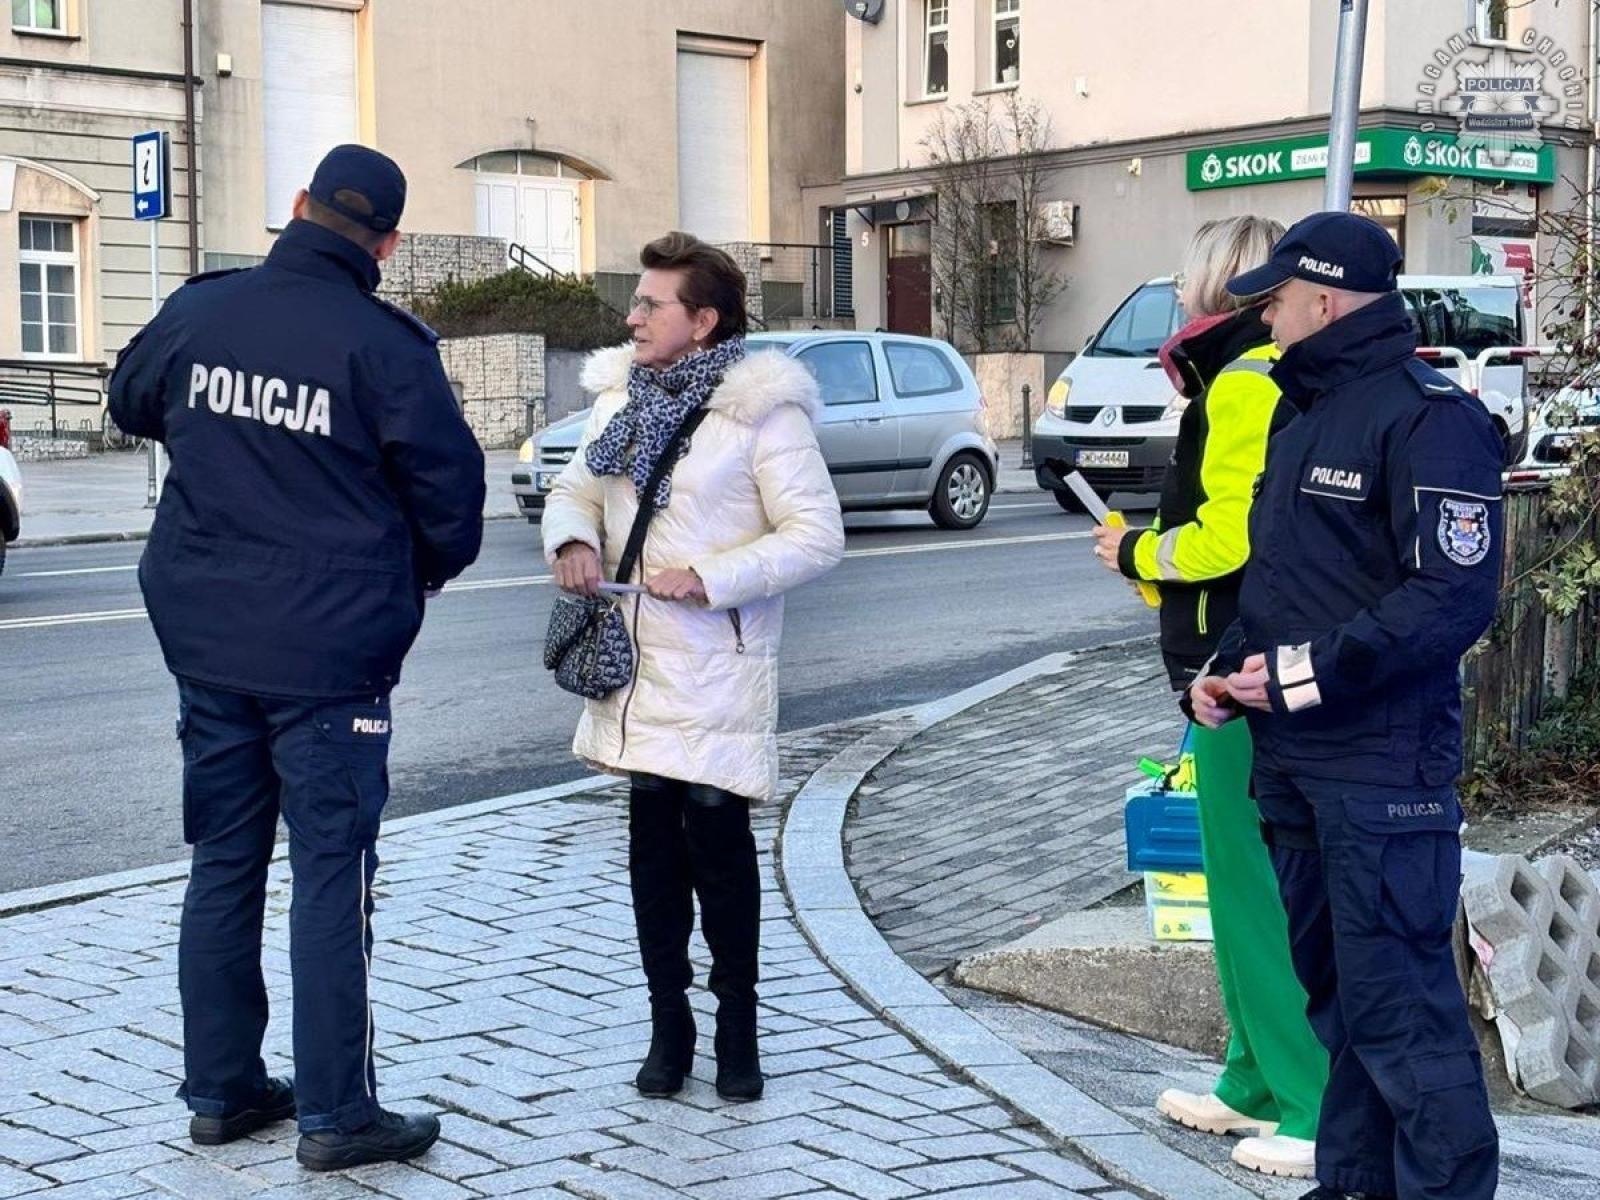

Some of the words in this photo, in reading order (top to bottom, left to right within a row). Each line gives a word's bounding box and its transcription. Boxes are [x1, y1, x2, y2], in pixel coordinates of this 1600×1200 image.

[1226, 152, 1283, 178] SKOK
[1425, 143, 1473, 168] SKOK
[862, 231, 869, 247] 5
[1298, 255, 1344, 279] POLICJA
[188, 363, 331, 436] POLICJA
[1310, 467, 1362, 490] POLICJA
[353, 718, 389, 733] POLICJ
[1387, 803, 1444, 818] POLICJA
